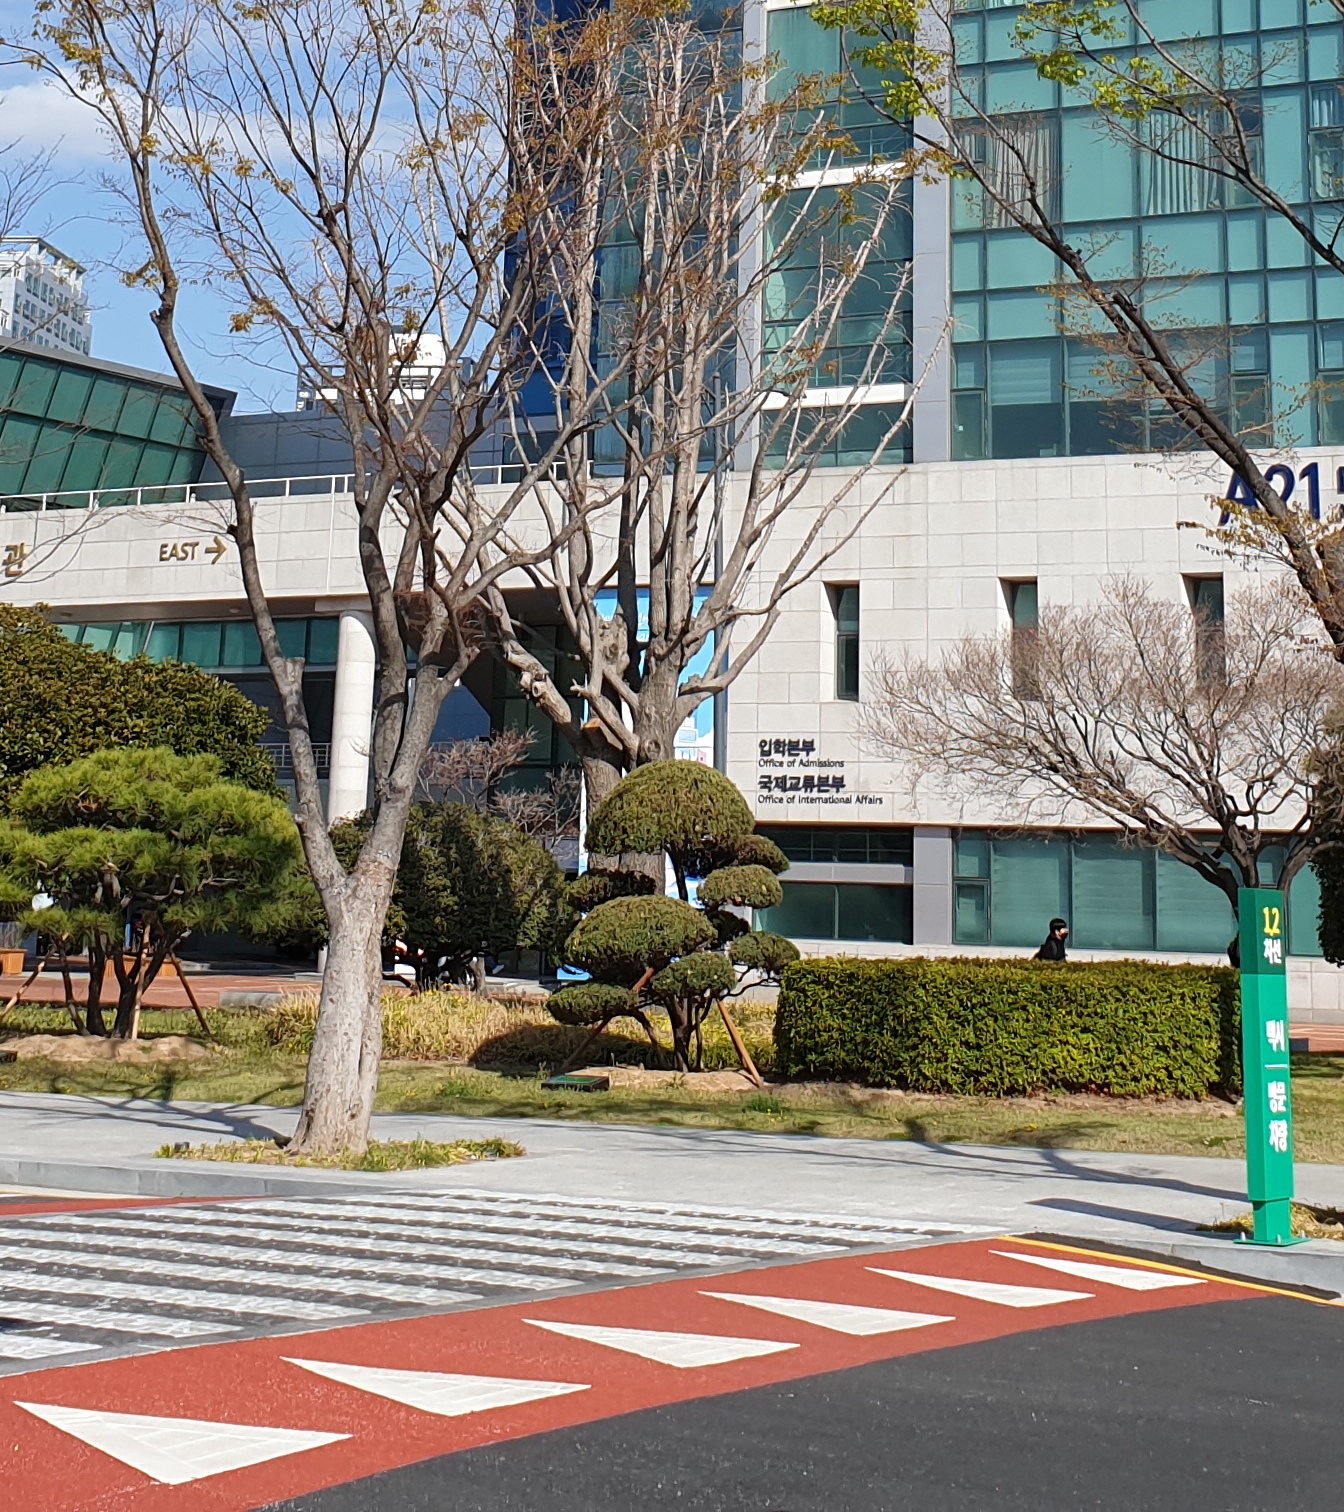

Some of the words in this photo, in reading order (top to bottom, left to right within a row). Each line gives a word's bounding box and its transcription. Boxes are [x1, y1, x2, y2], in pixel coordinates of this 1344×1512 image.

[1217, 462, 1320, 526] A21
[159, 541, 200, 562] EAST
[758, 738, 816, 757] 입학본부
[758, 758, 784, 768] Office
[787, 758, 796, 768] of
[798, 758, 844, 768] Admissions
[757, 774, 846, 793] 국제교류본부
[758, 794, 784, 804] Office
[786, 794, 796, 804] of
[798, 794, 852, 804] International
[855, 794, 884, 805] Affairs
[1263, 906, 1281, 936] 12
[1269, 1119, 1288, 1152] 차량
